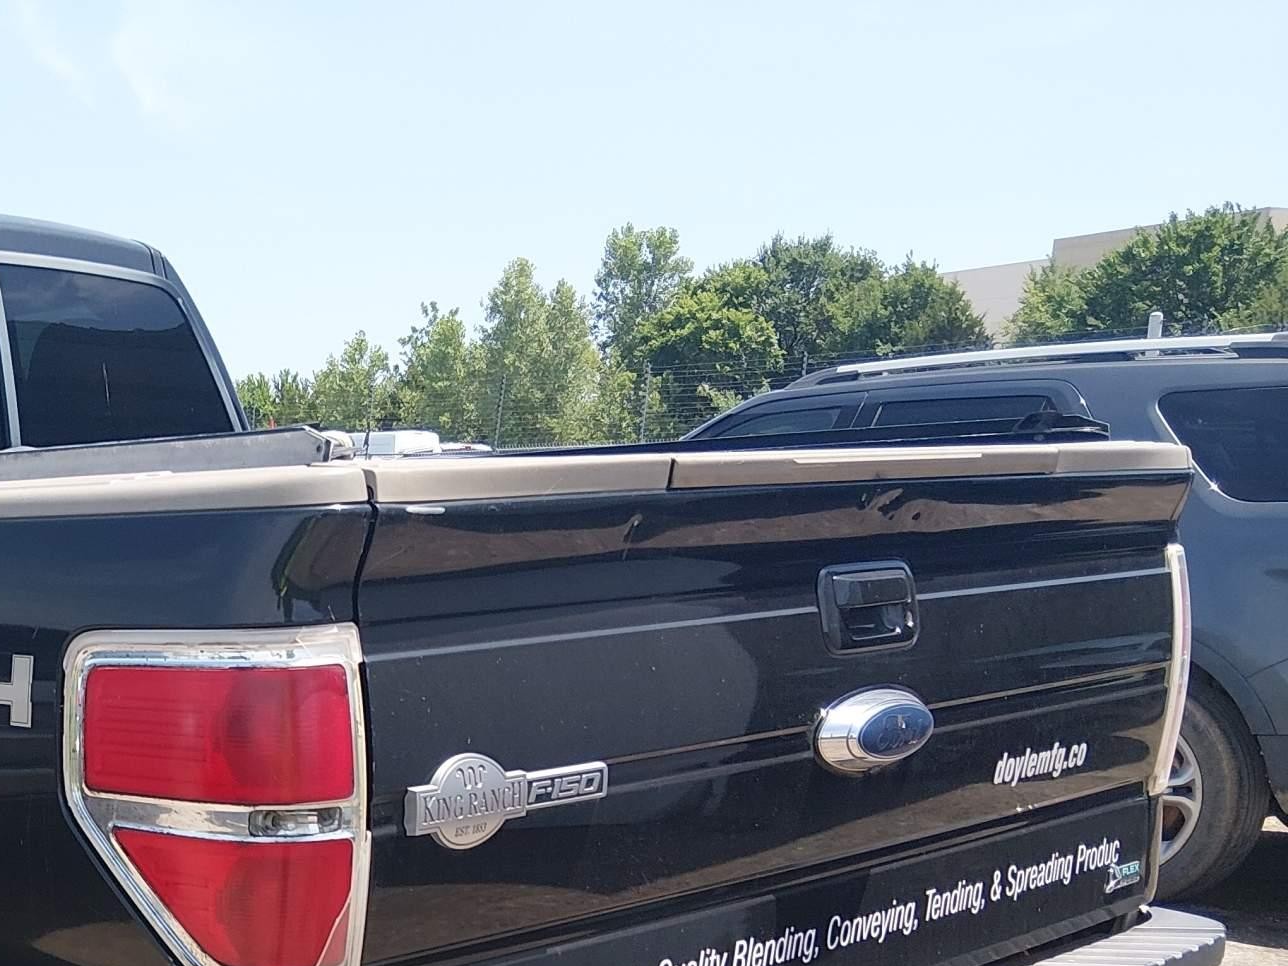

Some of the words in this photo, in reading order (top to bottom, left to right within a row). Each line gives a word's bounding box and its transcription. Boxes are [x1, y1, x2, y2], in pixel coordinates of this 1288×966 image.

[993, 742, 1087, 787] doylemfg.co
[422, 794, 464, 825] KING
[469, 781, 525, 817] RANCH
[527, 772, 602, 803] F-150
[1122, 863, 1140, 876] FLEX
[826, 900, 919, 950] Conveying,
[925, 880, 985, 921] Tending,
[990, 869, 1002, 901] &
[1005, 852, 1074, 901] Spreading
[1075, 837, 1120, 875] Produc
